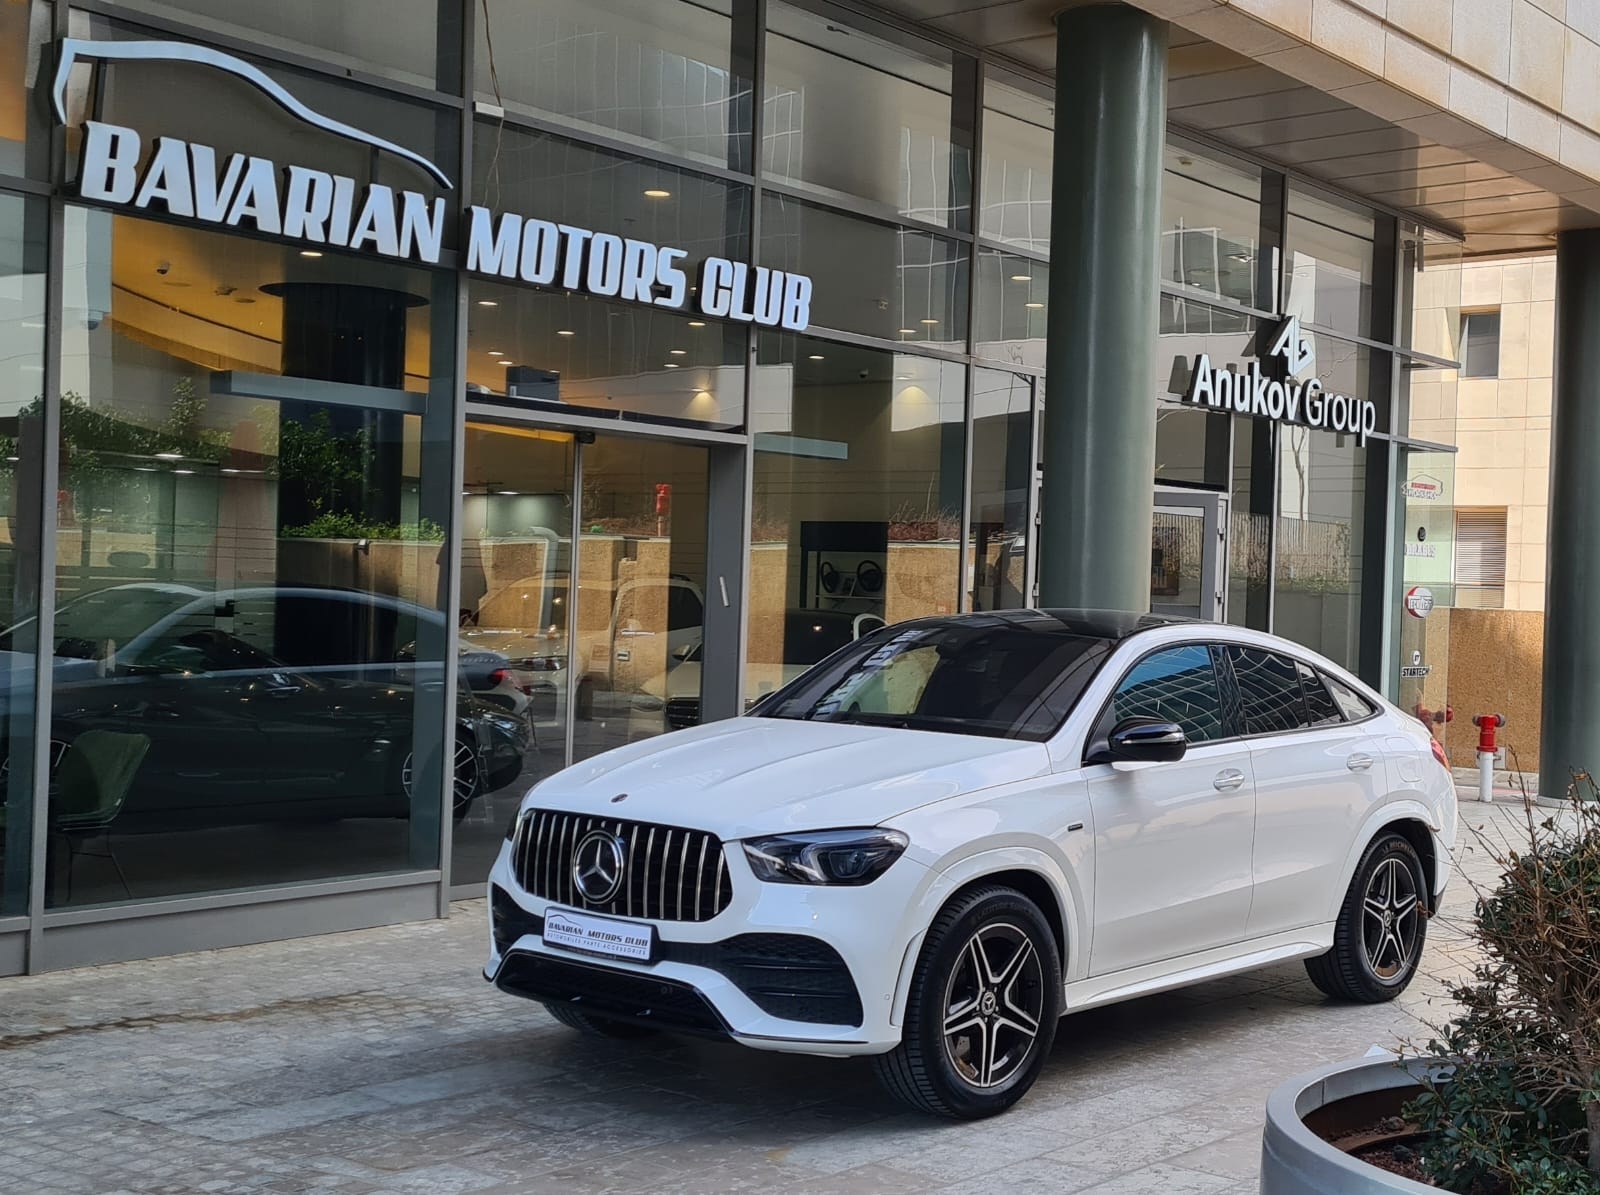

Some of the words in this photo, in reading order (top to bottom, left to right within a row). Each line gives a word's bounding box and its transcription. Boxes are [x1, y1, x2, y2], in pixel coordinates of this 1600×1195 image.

[81, 120, 446, 264] BAVARIAN
[466, 205, 689, 308] MOTORS
[700, 256, 813, 332] CLUB
[1191, 353, 1301, 421] Anukov
[1305, 378, 1377, 448] Group
[548, 921, 583, 936] BAVARIAN
[587, 930, 622, 943] MOTORS
[624, 936, 649, 947] CLUB
